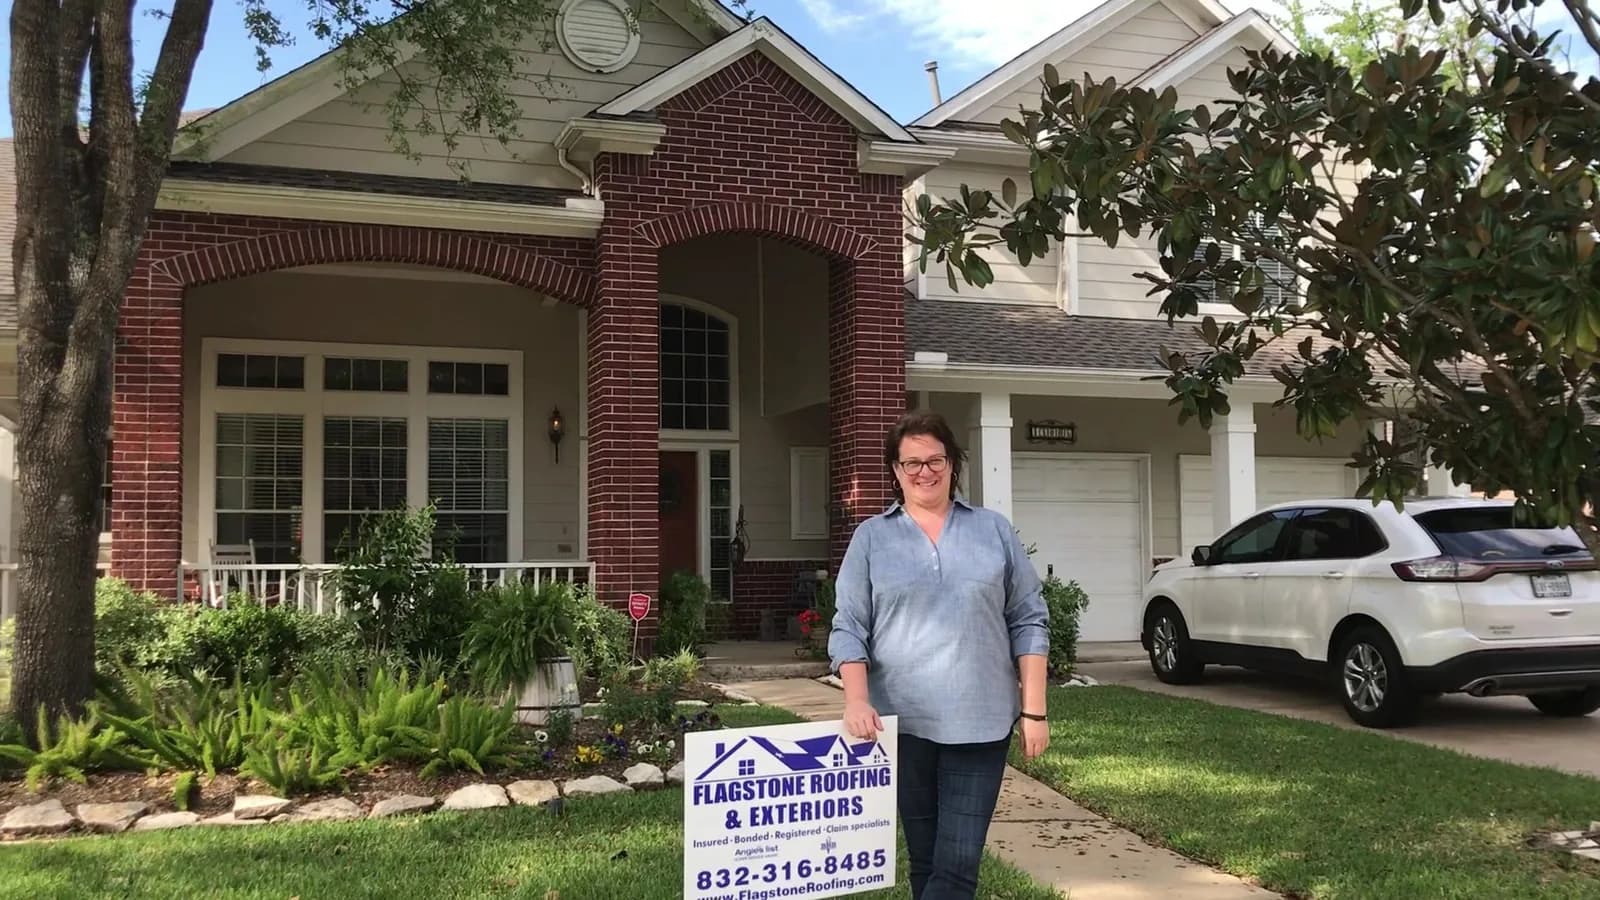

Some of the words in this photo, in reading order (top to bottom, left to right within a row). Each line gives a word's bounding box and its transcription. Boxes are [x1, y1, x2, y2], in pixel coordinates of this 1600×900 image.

[693, 774, 805, 806] FLAGSTONE
[810, 767, 891, 791] ROOFING
[725, 809, 742, 830] &
[750, 796, 863, 827] EXTERIORS
[693, 836, 729, 848] Insured
[734, 832, 769, 844] Bonded
[775, 825, 821, 840] Registered
[826, 824, 849, 833] Claim
[850, 819, 890, 831] specialists
[697, 849, 886, 890] 832-316-8485
[697, 873, 885, 900] w.FlagstoneRoofing.com
